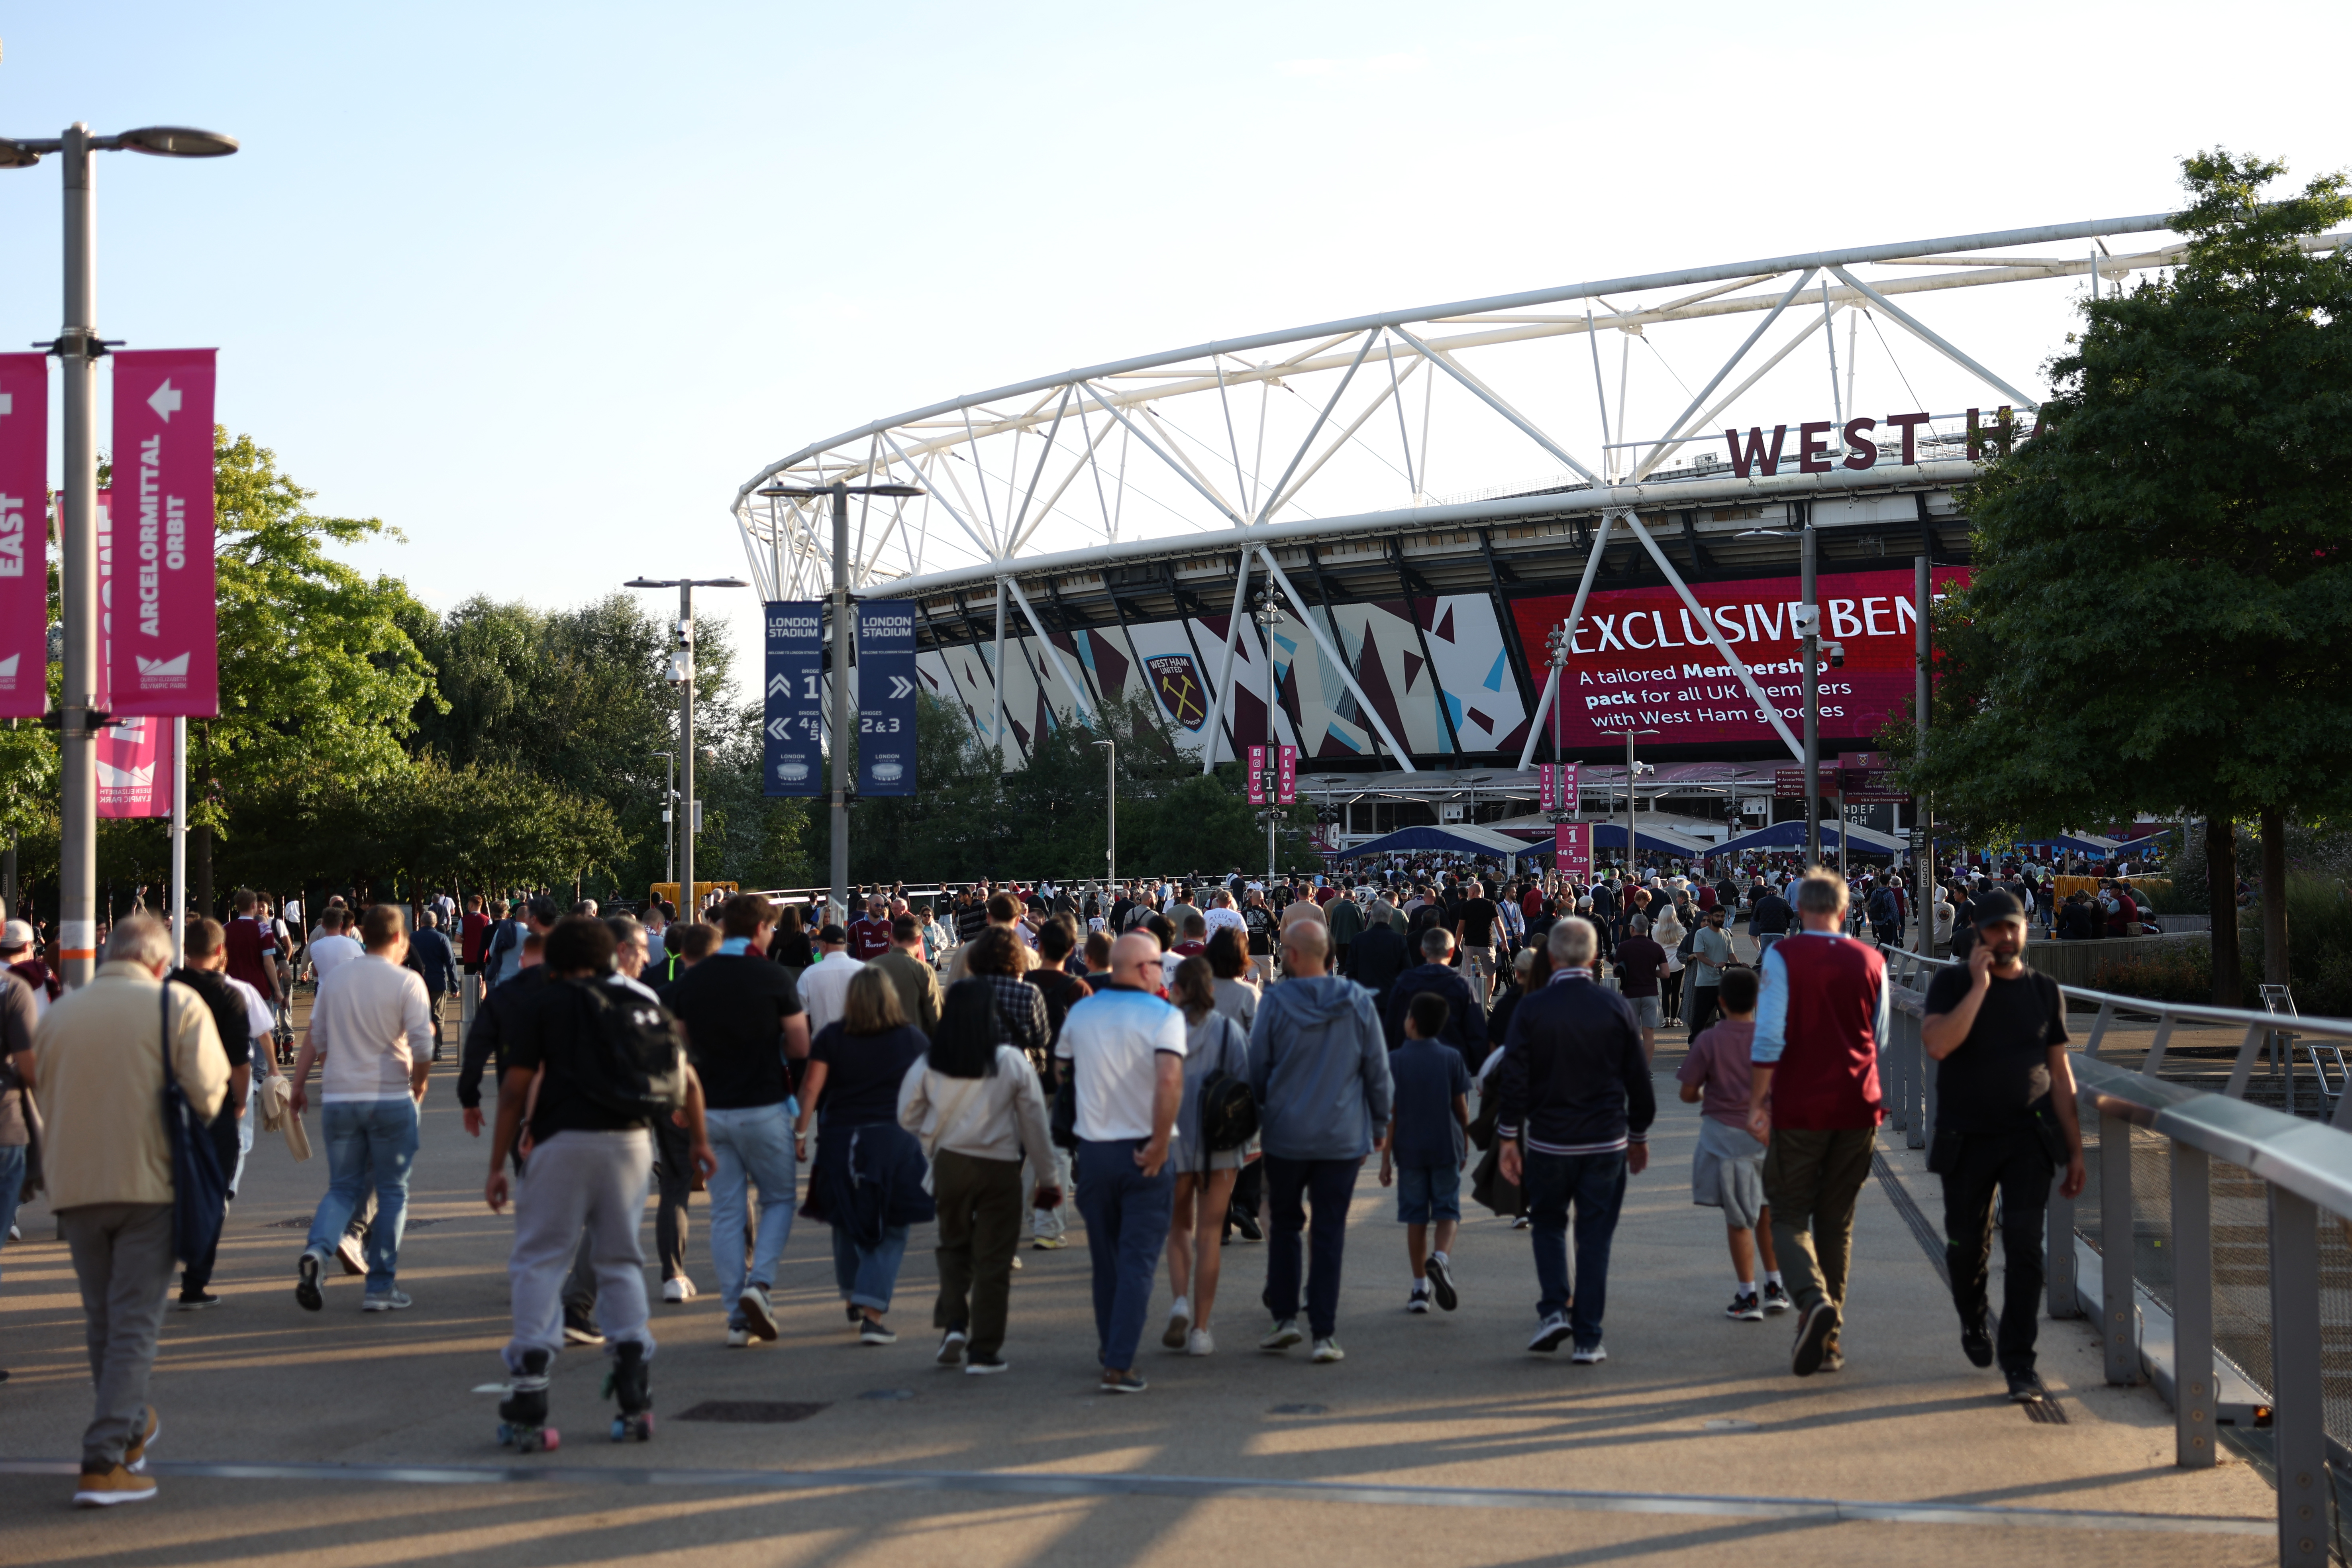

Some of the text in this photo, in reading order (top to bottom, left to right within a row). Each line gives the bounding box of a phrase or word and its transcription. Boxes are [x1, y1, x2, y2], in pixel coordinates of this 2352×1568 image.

[1725, 412, 1930, 478] WEST
[0, 493, 23, 577] EAST
[139, 435, 159, 637] ARCELORMITTAL
[166, 495, 186, 570] ORBIT
[769, 618, 817, 627] LONDON
[863, 617, 911, 627] LONDON
[769, 628, 817, 637] STADIUM
[863, 628, 911, 637] STADIUM
[1150, 658, 1189, 669] WEST HAM
[1580, 657, 1828, 686] A tailored Membershp
[804, 676, 819, 699] 1
[1585, 690, 1637, 710] pack
[1641, 689, 1671, 704] for
[1677, 687, 1702, 701] all
[1708, 685, 1740, 700] UK
[799, 718, 819, 729] 4 &
[861, 718, 900, 732] 2 & 3
[1591, 712, 1635, 728] with
[1639, 709, 1692, 725] West
[1697, 707, 1748, 722] Ham
[810, 729, 819, 740] 5
[1283, 748, 1291, 791] PLAY
[1266, 777, 1273, 789] 1
[1567, 765, 1575, 800] WORK
[1569, 830, 1577, 843] 1
